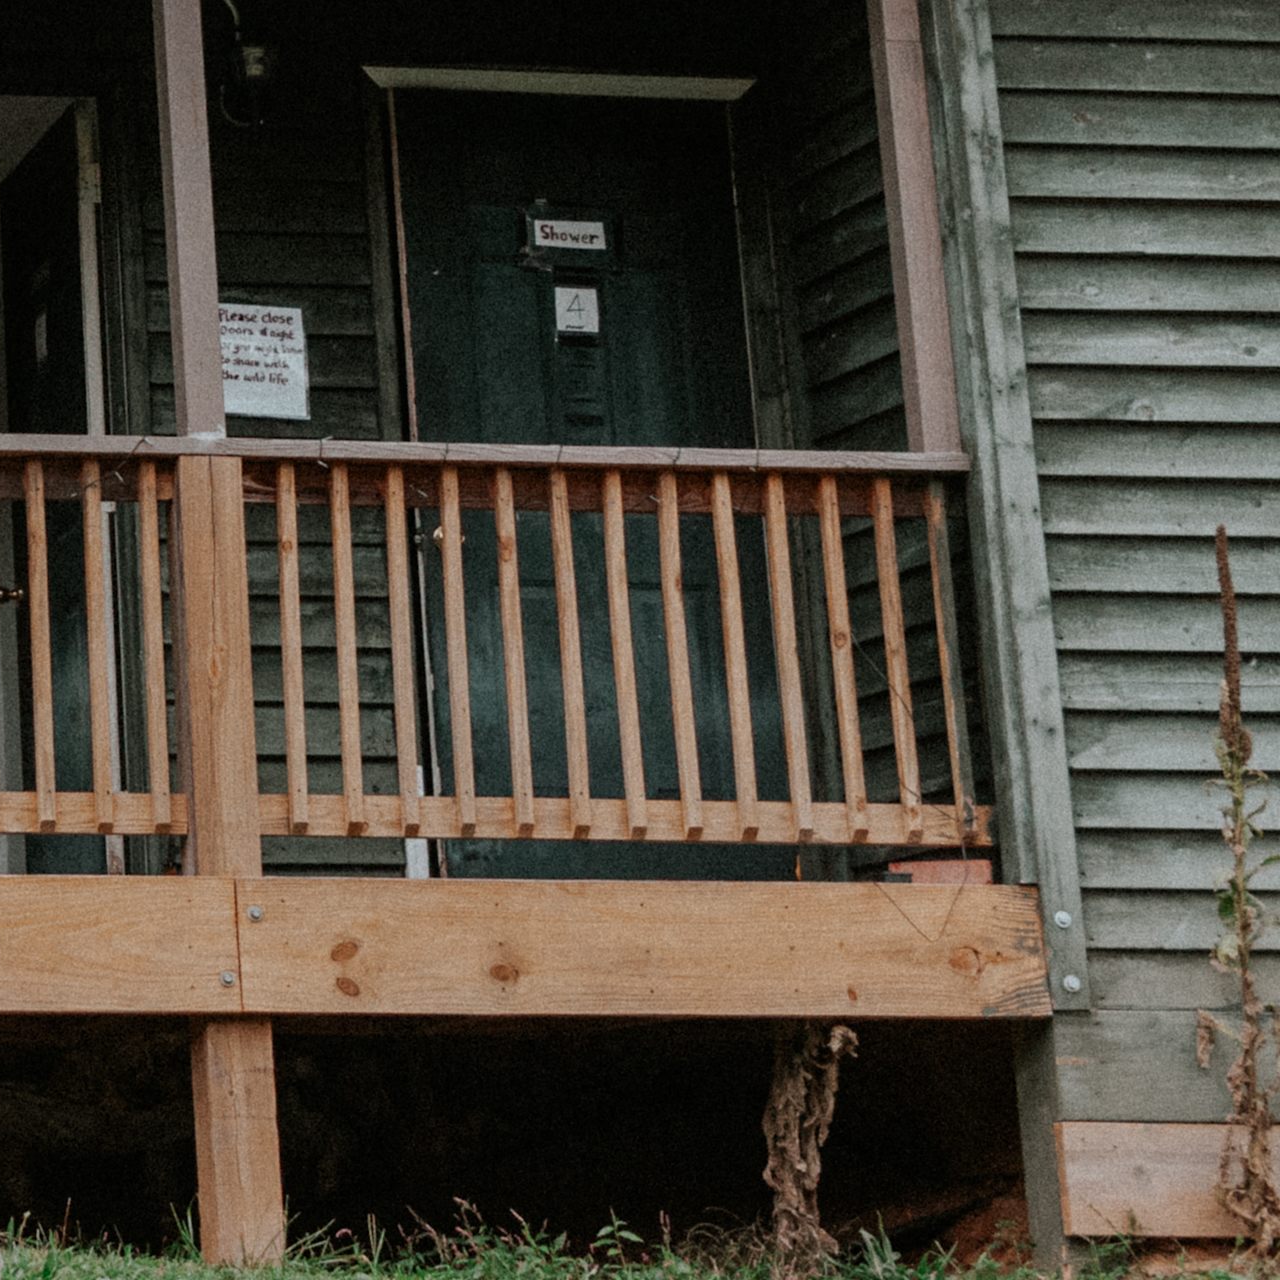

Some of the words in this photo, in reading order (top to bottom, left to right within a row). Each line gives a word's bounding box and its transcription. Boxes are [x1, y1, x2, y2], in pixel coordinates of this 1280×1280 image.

[540, 224, 599, 244] Shower
[566, 293, 585, 321] 4
[218, 308, 258, 323] Please
[261, 312, 294, 325] close
[220, 325, 254, 336] Doors
